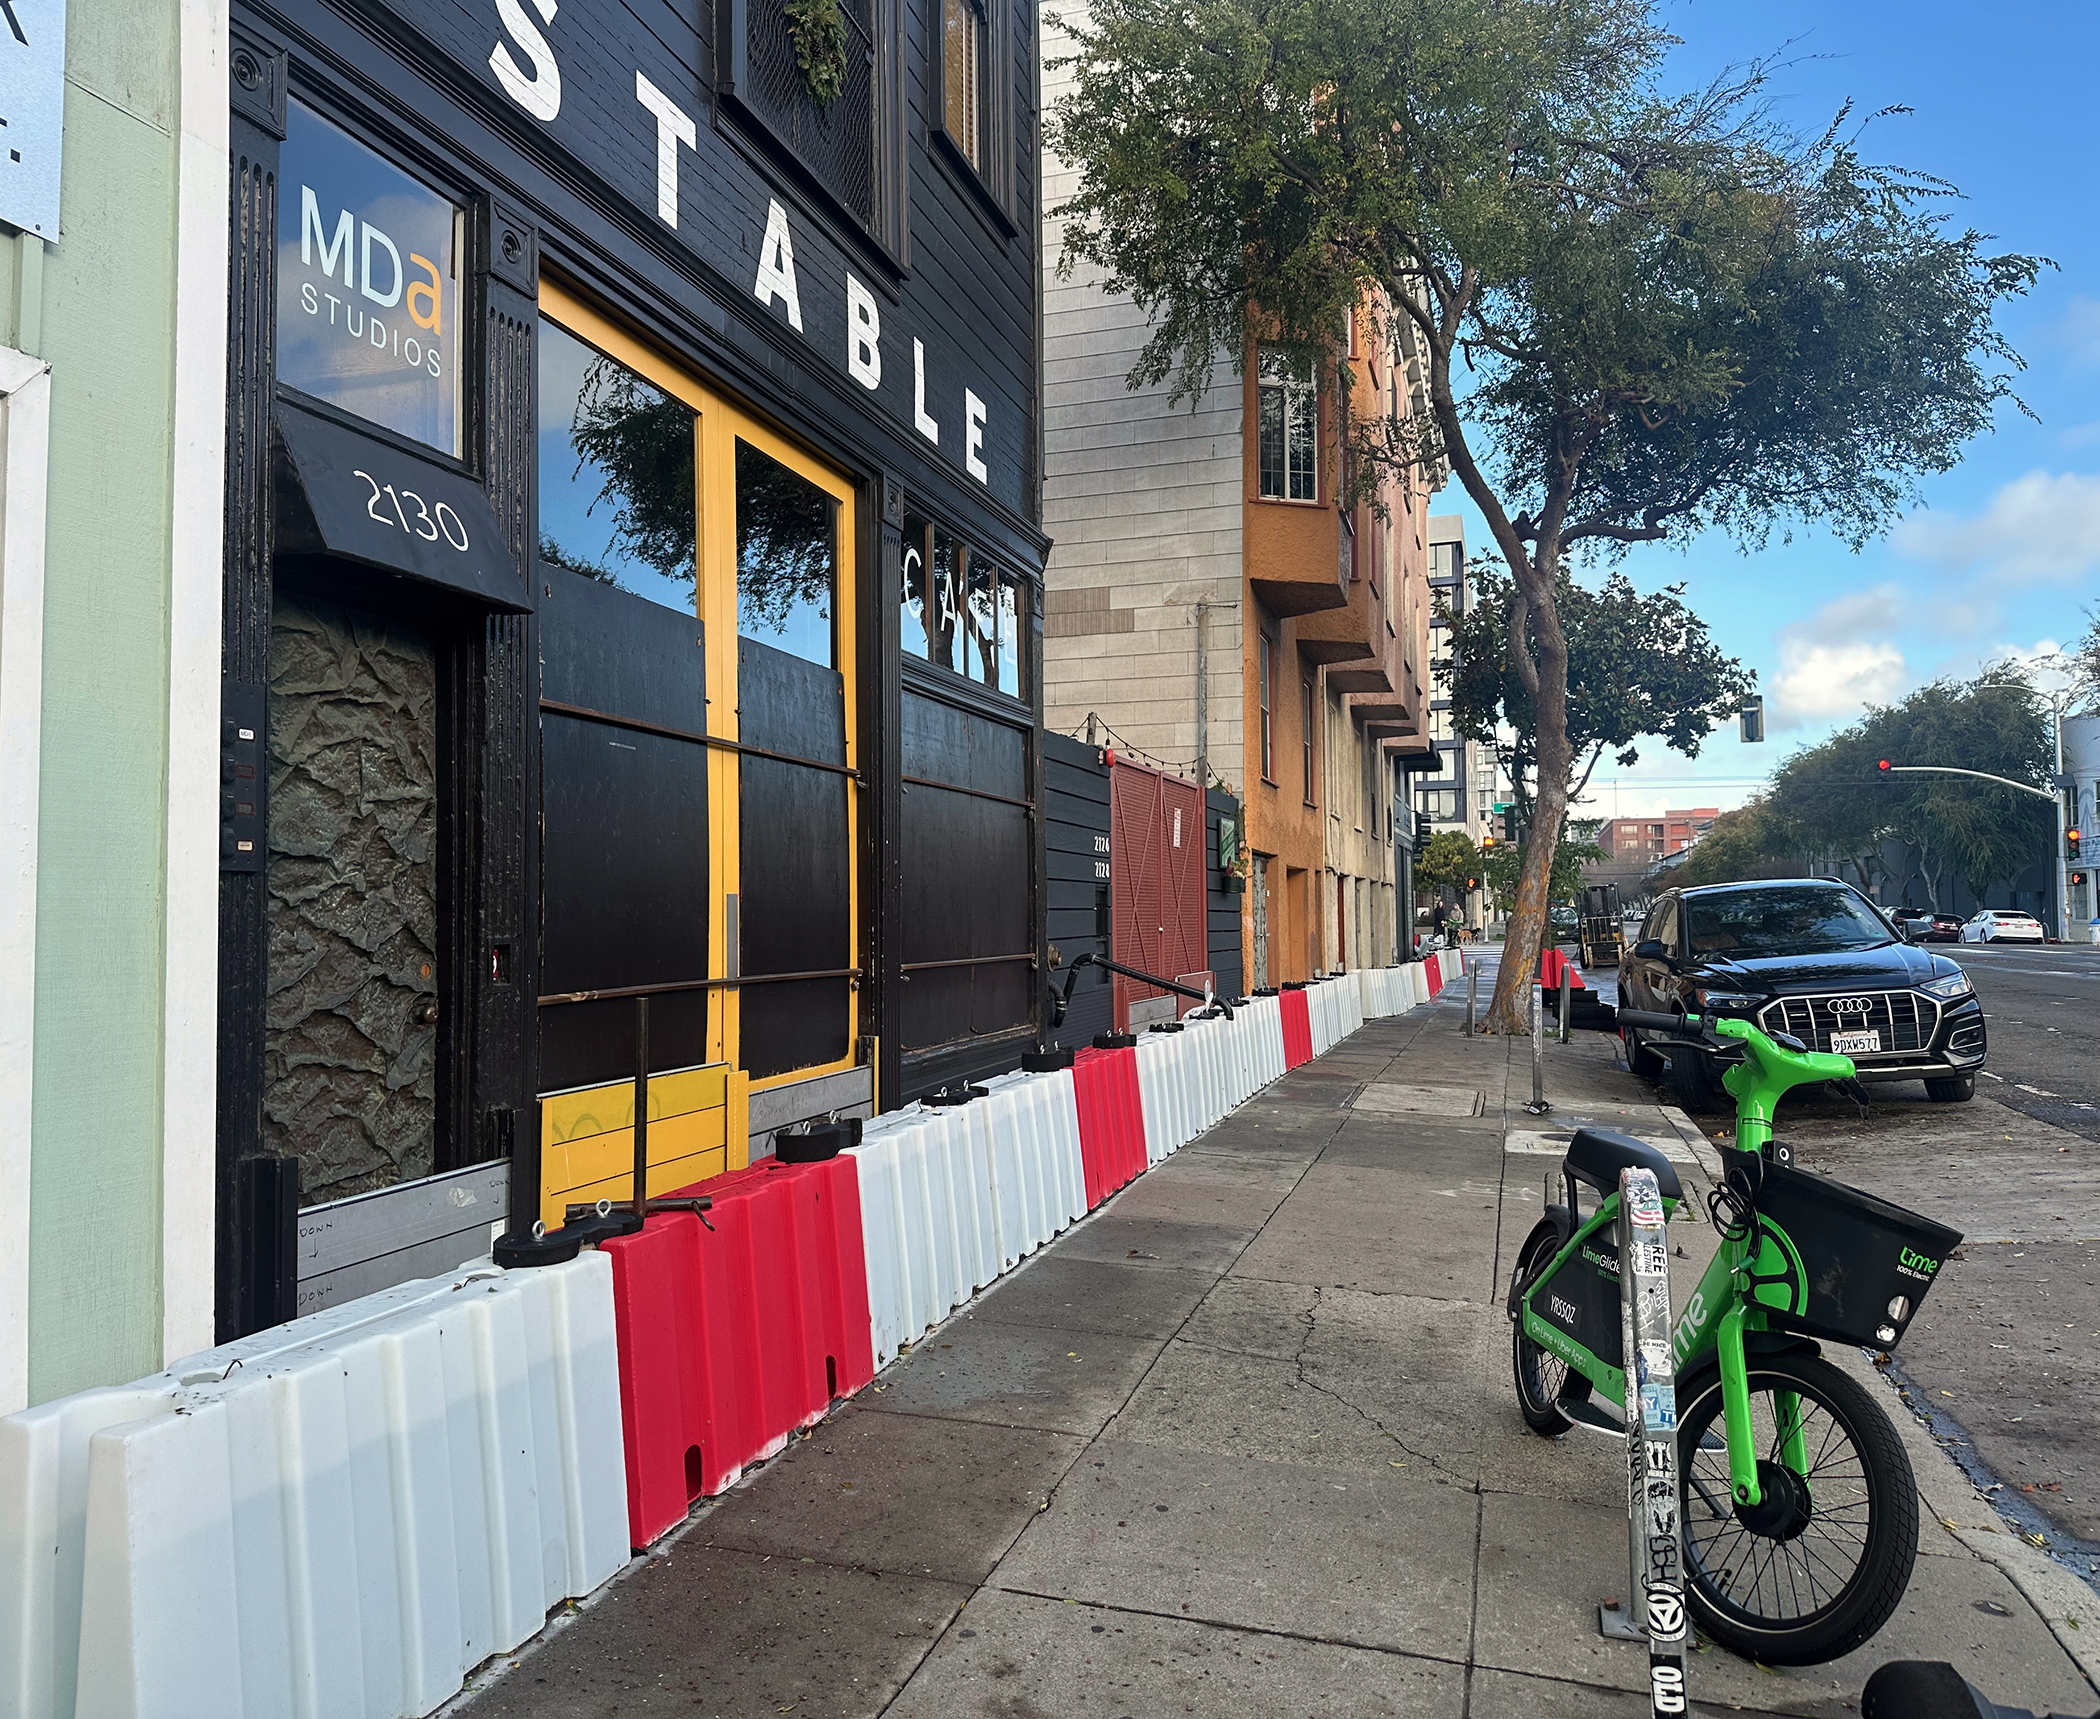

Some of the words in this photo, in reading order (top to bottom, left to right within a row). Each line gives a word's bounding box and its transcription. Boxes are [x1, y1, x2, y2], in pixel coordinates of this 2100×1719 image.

[488, 0, 988, 486] STABLE
[301, 184, 442, 336] MDa
[301, 282, 442, 378] STUDIOS
[353, 469, 470, 552] 2130
[1094, 835, 1110, 853] 2126
[1094, 861, 1110, 878] 2128
[1833, 1037, 1878, 1052] 9DXW577
[1840, 1031, 1869, 1039] California
[299, 1219, 334, 1238] DOWN
[1652, 1245, 1667, 1274] REE
[1896, 1264, 1913, 1277] 100%
[1912, 1271, 1931, 1282] Electric
[298, 1281, 334, 1307] DOWN
[1531, 1321, 1541, 1336] On
[1540, 1328, 1554, 1345] Lime
[1556, 1339, 1572, 1356] Uber
[1570, 1348, 1587, 1368] Apps
